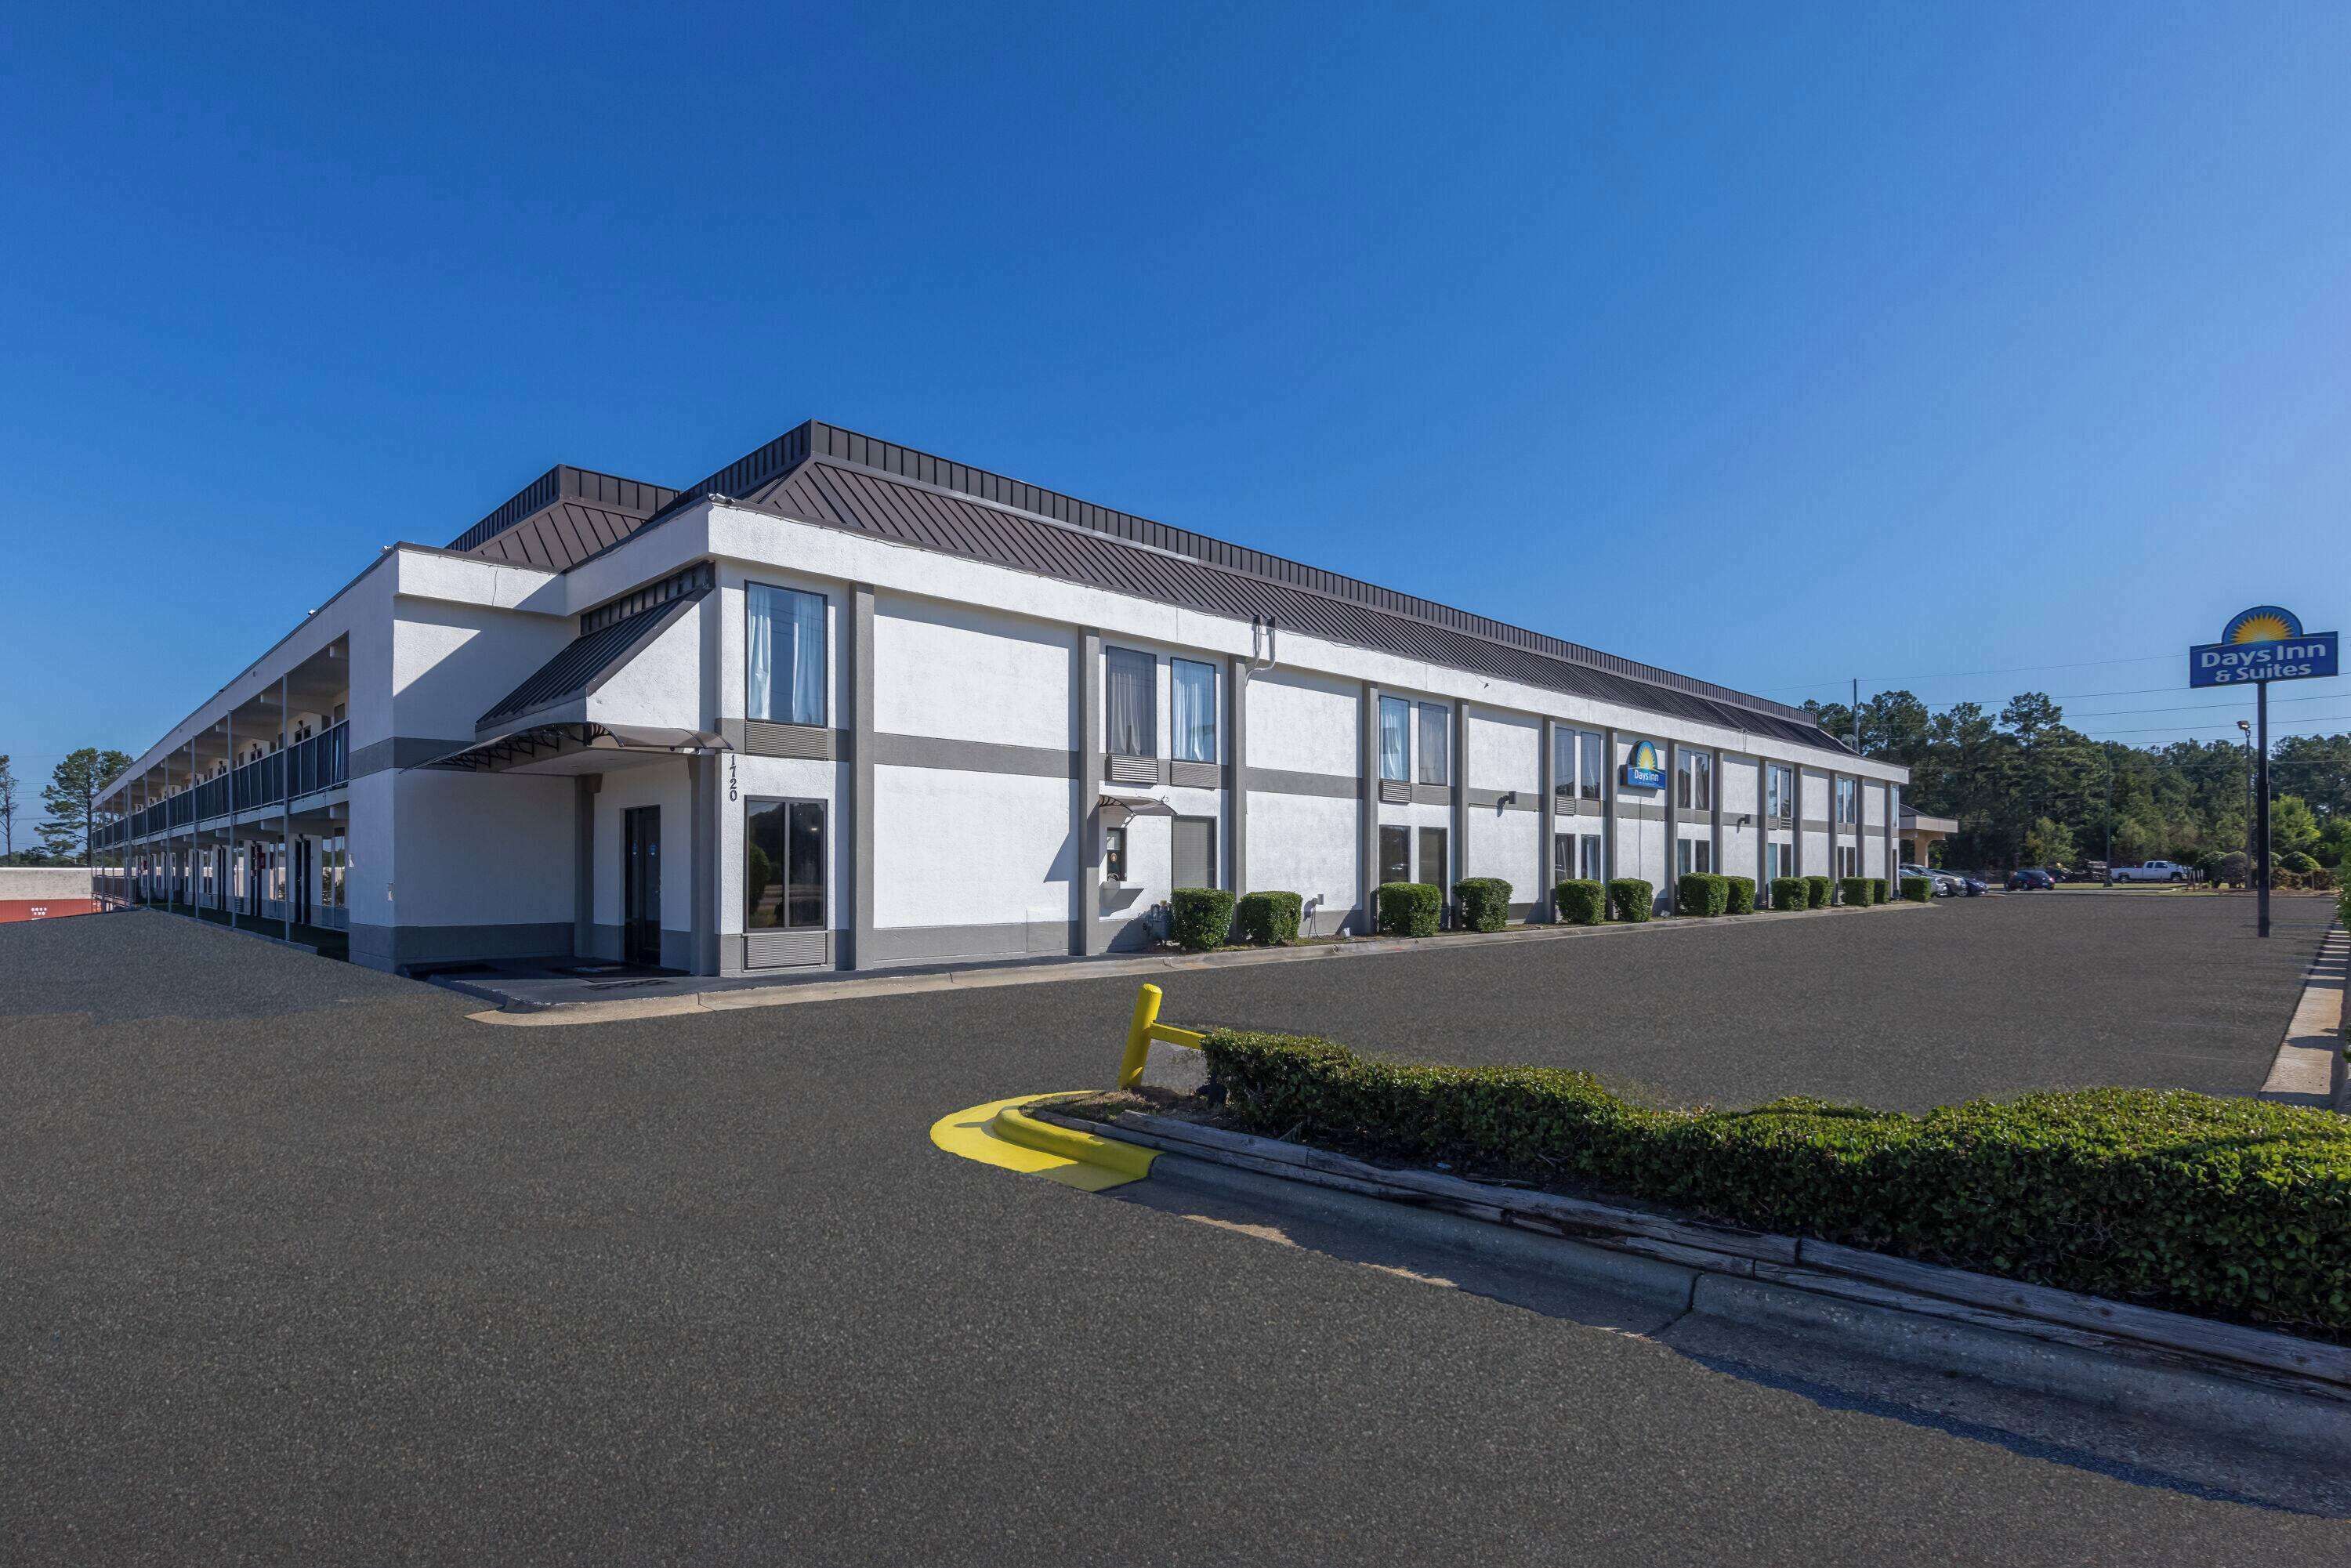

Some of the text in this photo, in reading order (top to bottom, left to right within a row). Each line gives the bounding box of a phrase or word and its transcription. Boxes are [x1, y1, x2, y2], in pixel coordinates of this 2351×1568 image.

[2201, 643, 2327, 668] Days Inn
[2214, 663, 2312, 683] & Suites
[729, 754, 737, 802] 1720
[1634, 770, 1659, 781] Days Inn
